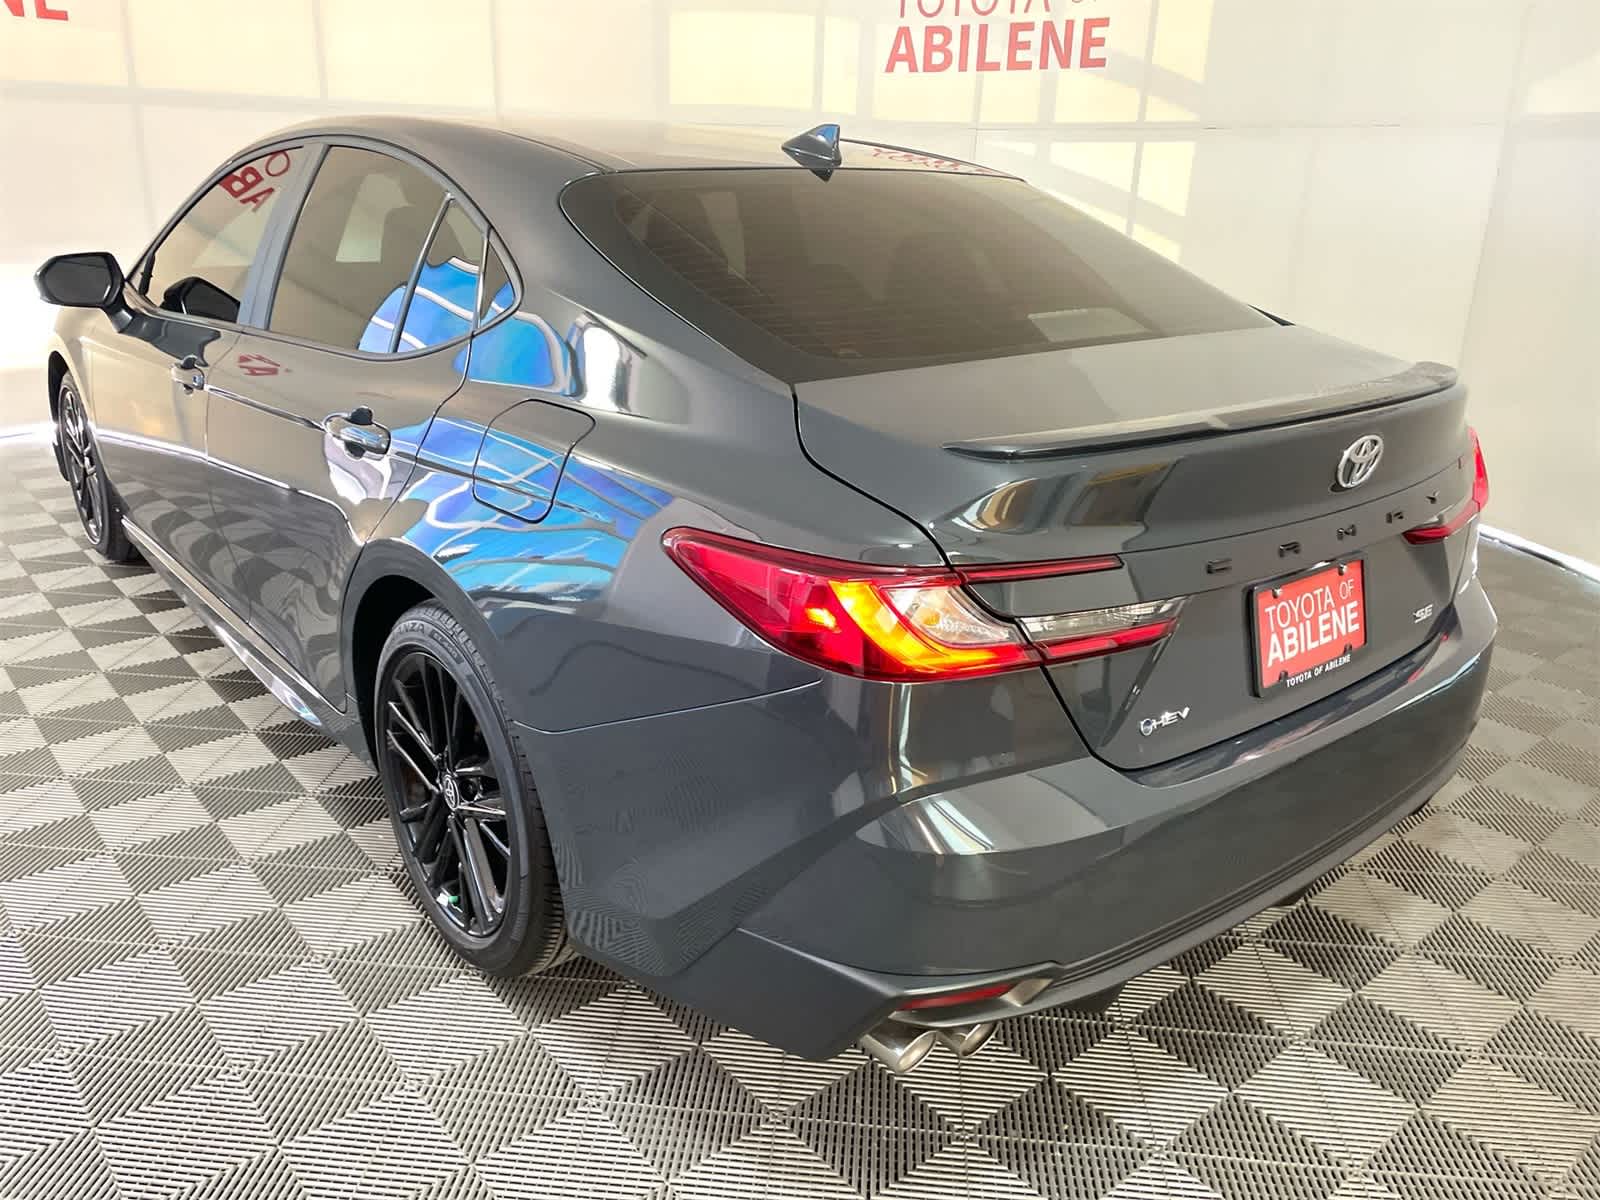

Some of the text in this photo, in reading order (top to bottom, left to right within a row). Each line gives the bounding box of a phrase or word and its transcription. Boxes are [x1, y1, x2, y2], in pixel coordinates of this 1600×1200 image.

[885, 17, 1110, 73] ABILENE
[1264, 578, 1355, 632] TOYOTA OF
[1412, 603, 1433, 624] SE
[1267, 600, 1361, 668] ABILENE
[1286, 653, 1352, 688] TOYOTA OF ABILENE
